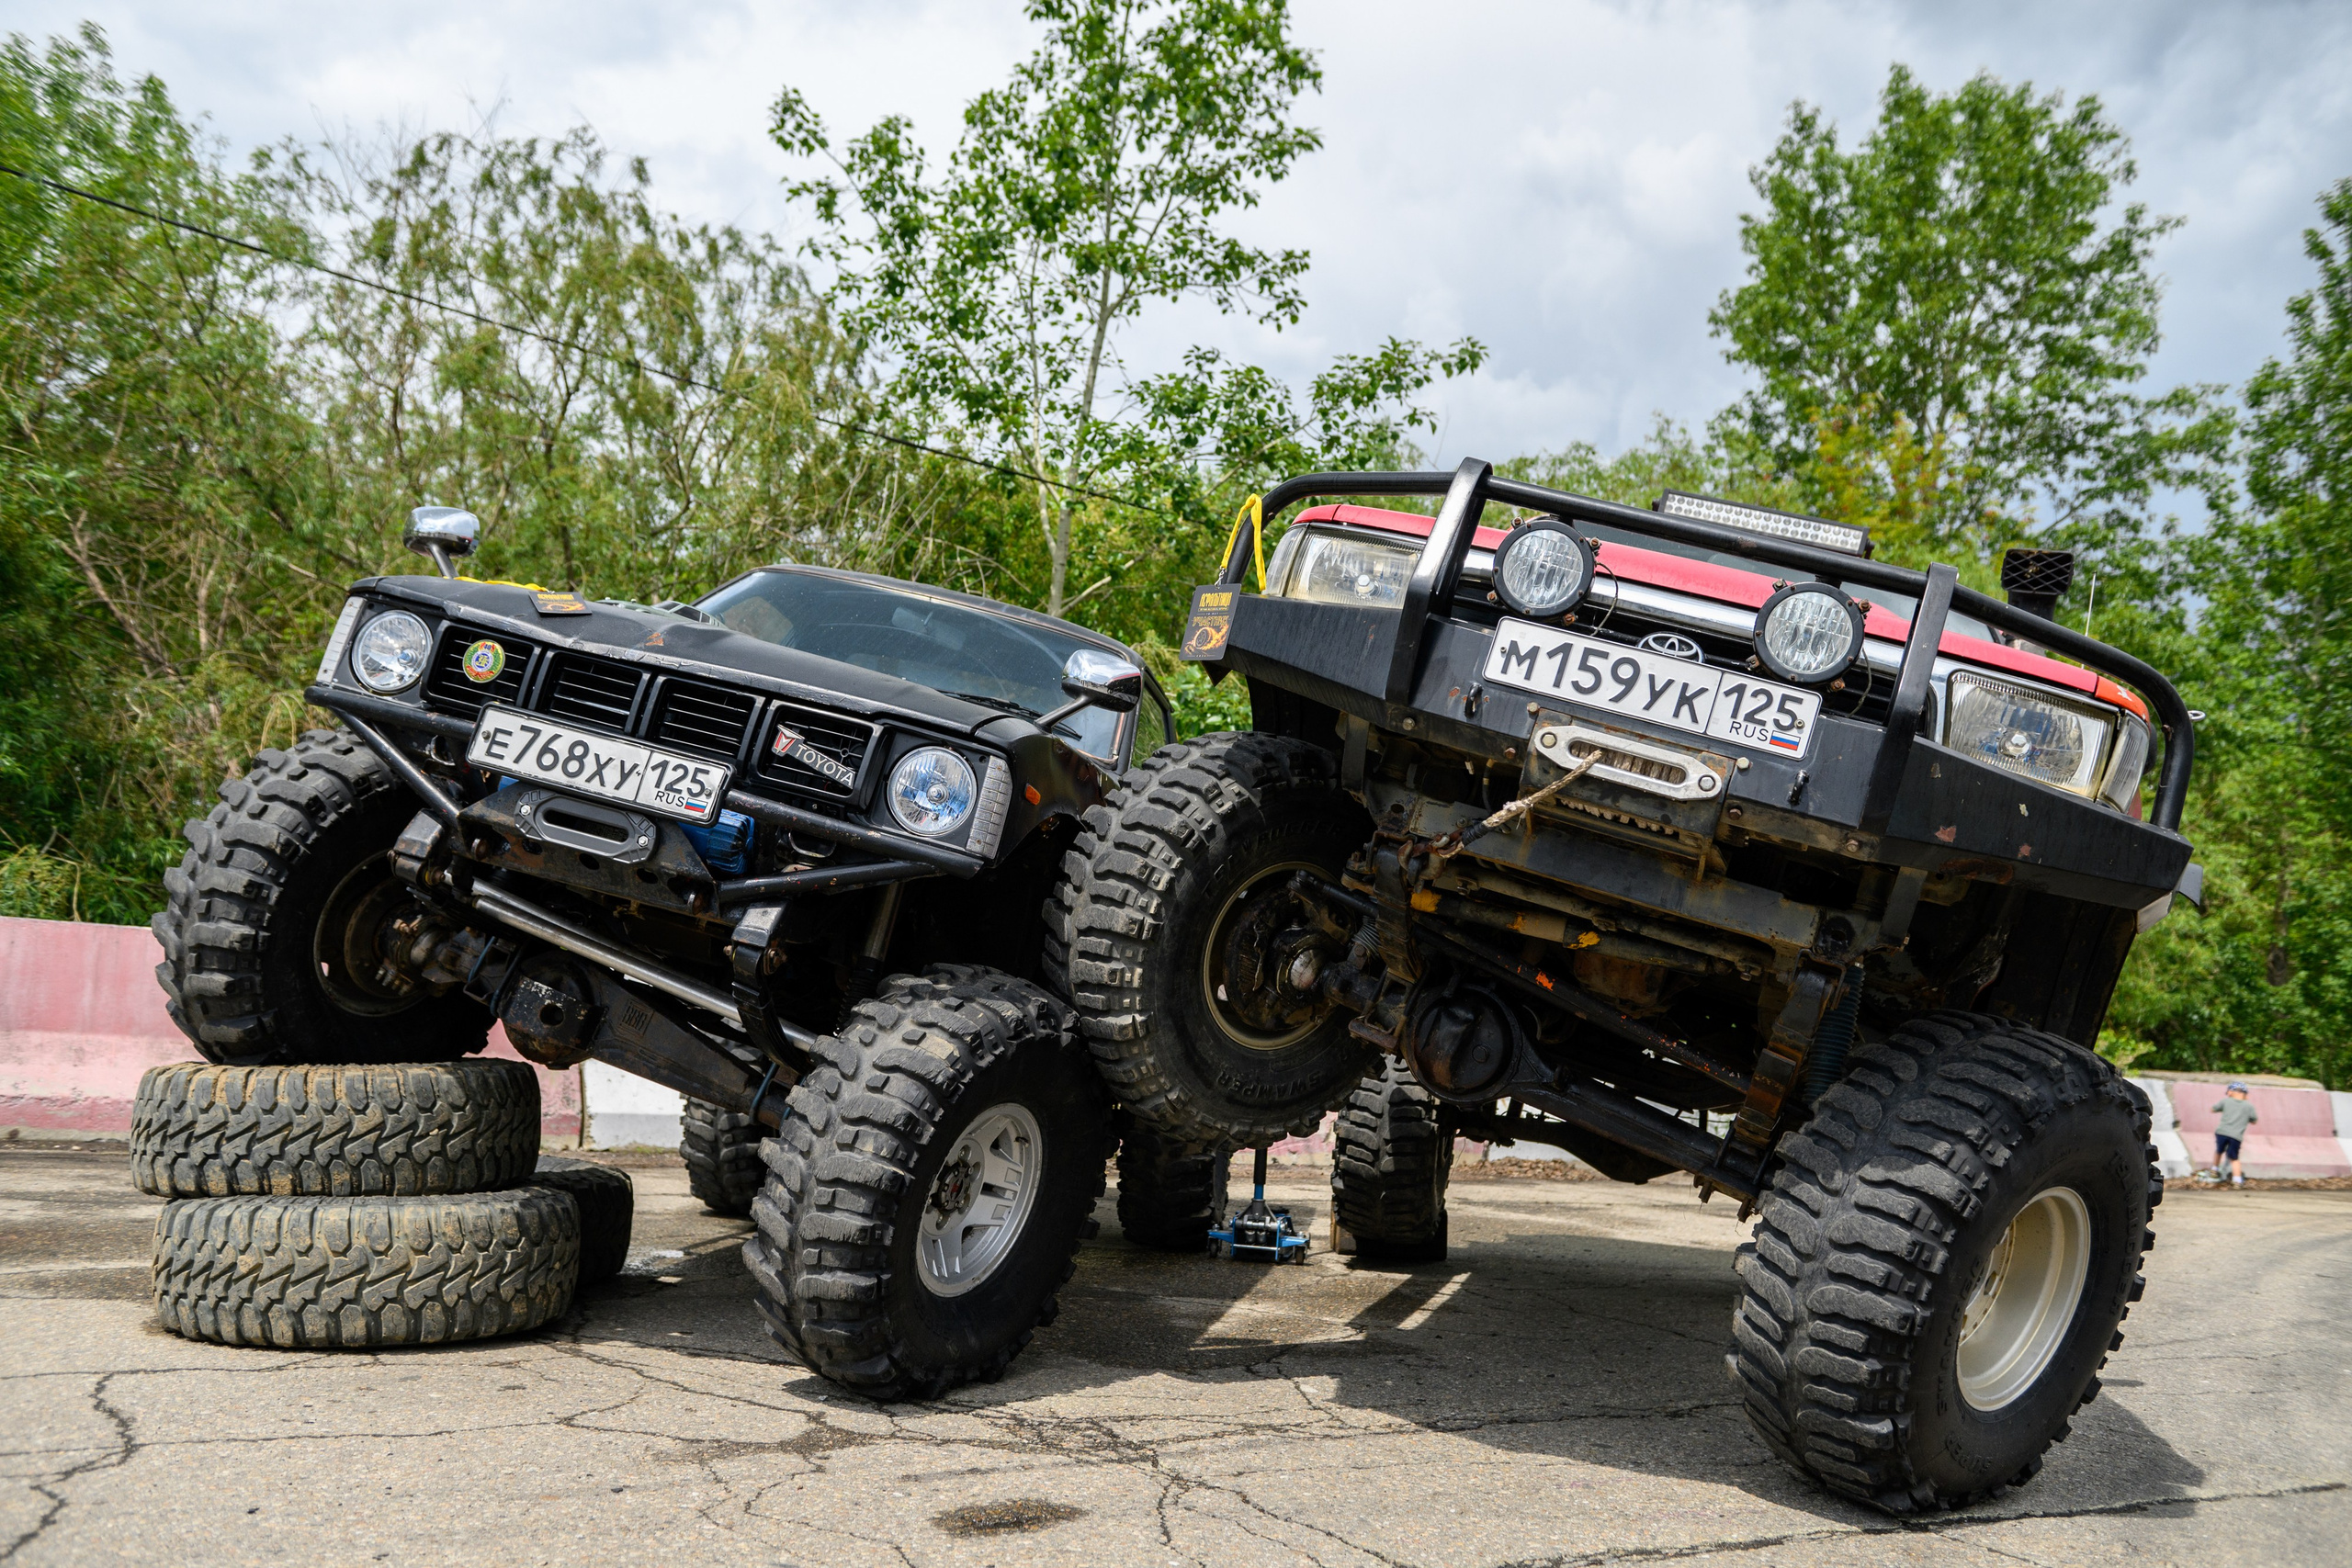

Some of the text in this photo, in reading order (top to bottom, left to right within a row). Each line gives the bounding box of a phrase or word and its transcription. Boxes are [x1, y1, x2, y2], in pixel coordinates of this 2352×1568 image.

[1499, 638, 1804, 731] М159УК 125
[1729, 720, 1770, 742] RUS
[484, 723, 711, 798] Е768ХУ 125
[795, 743, 854, 787] TOYOTA
[654, 790, 685, 807] RUS
[1216, 1069, 1324, 1101] SWAMPER
[1936, 1256, 1983, 1417] SWAMPER
